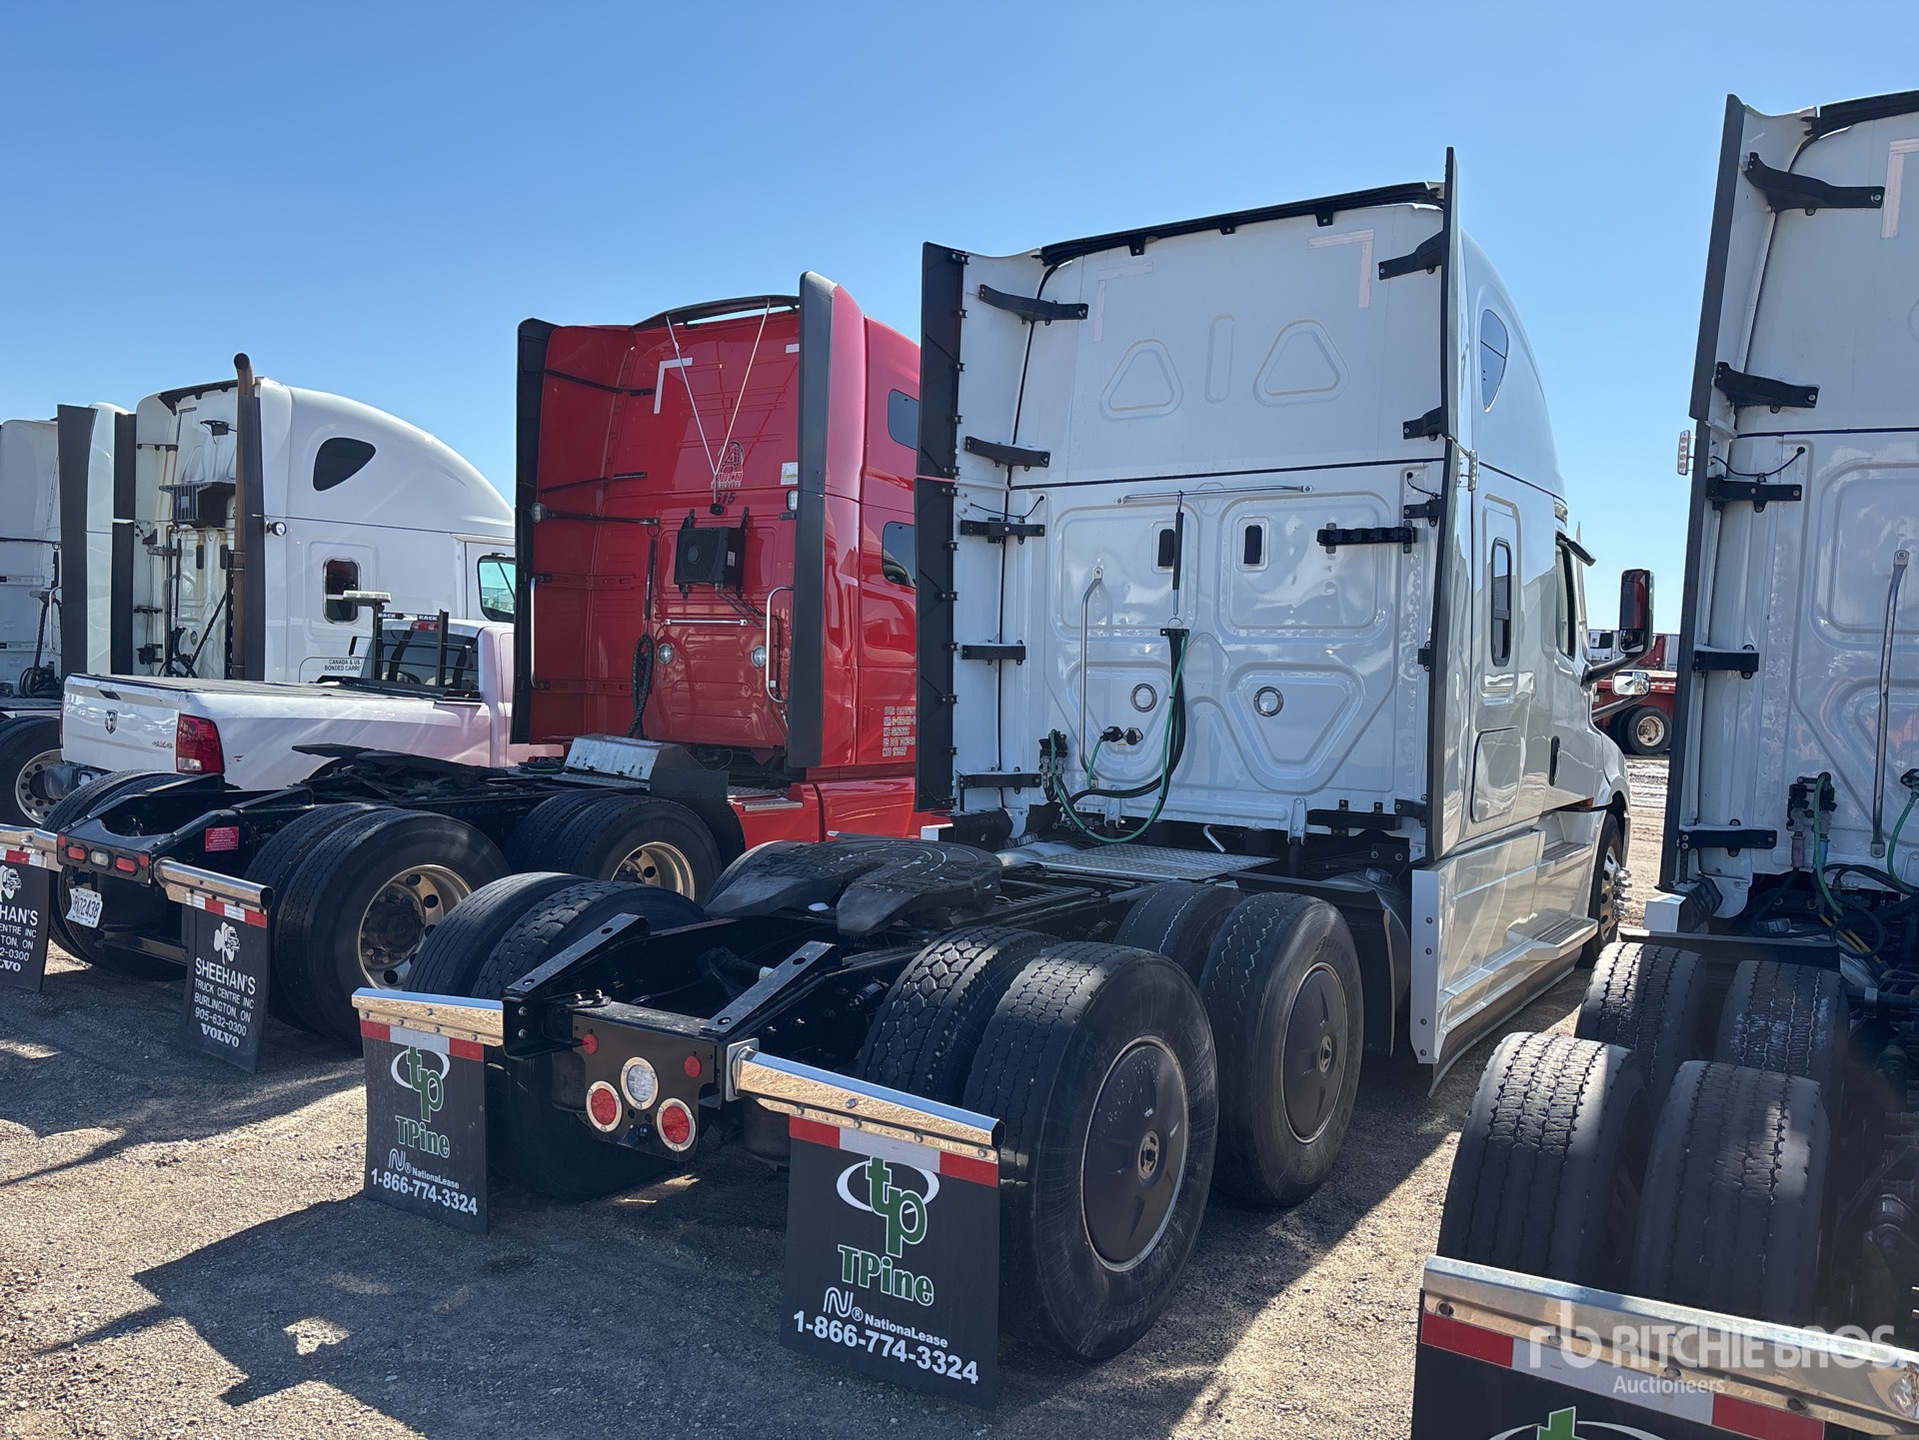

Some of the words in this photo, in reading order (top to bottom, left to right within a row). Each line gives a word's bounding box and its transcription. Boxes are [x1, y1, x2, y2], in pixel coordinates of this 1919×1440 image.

[22, 939, 34, 950] ON
[24, 928, 37, 938] INC
[195, 957, 256, 995] SHEEHAN'S
[194, 978, 215, 994] TRUCK
[217, 987, 241, 1004] CENTRE
[243, 996, 255, 1010] INC
[194, 992, 238, 1020] BURLINGTON,
[240, 1011, 251, 1023] ON
[194, 1006, 247, 1037] 905-632-0300
[201, 1022, 240, 1048] VOLVO
[395, 1114, 450, 1159] TPine
[371, 1167, 478, 1216] 1-866-774-3324
[837, 1244, 934, 1307] TPine
[864, 1313, 948, 1348] NationaLease
[793, 1310, 979, 1385] 1-866-774-3324
